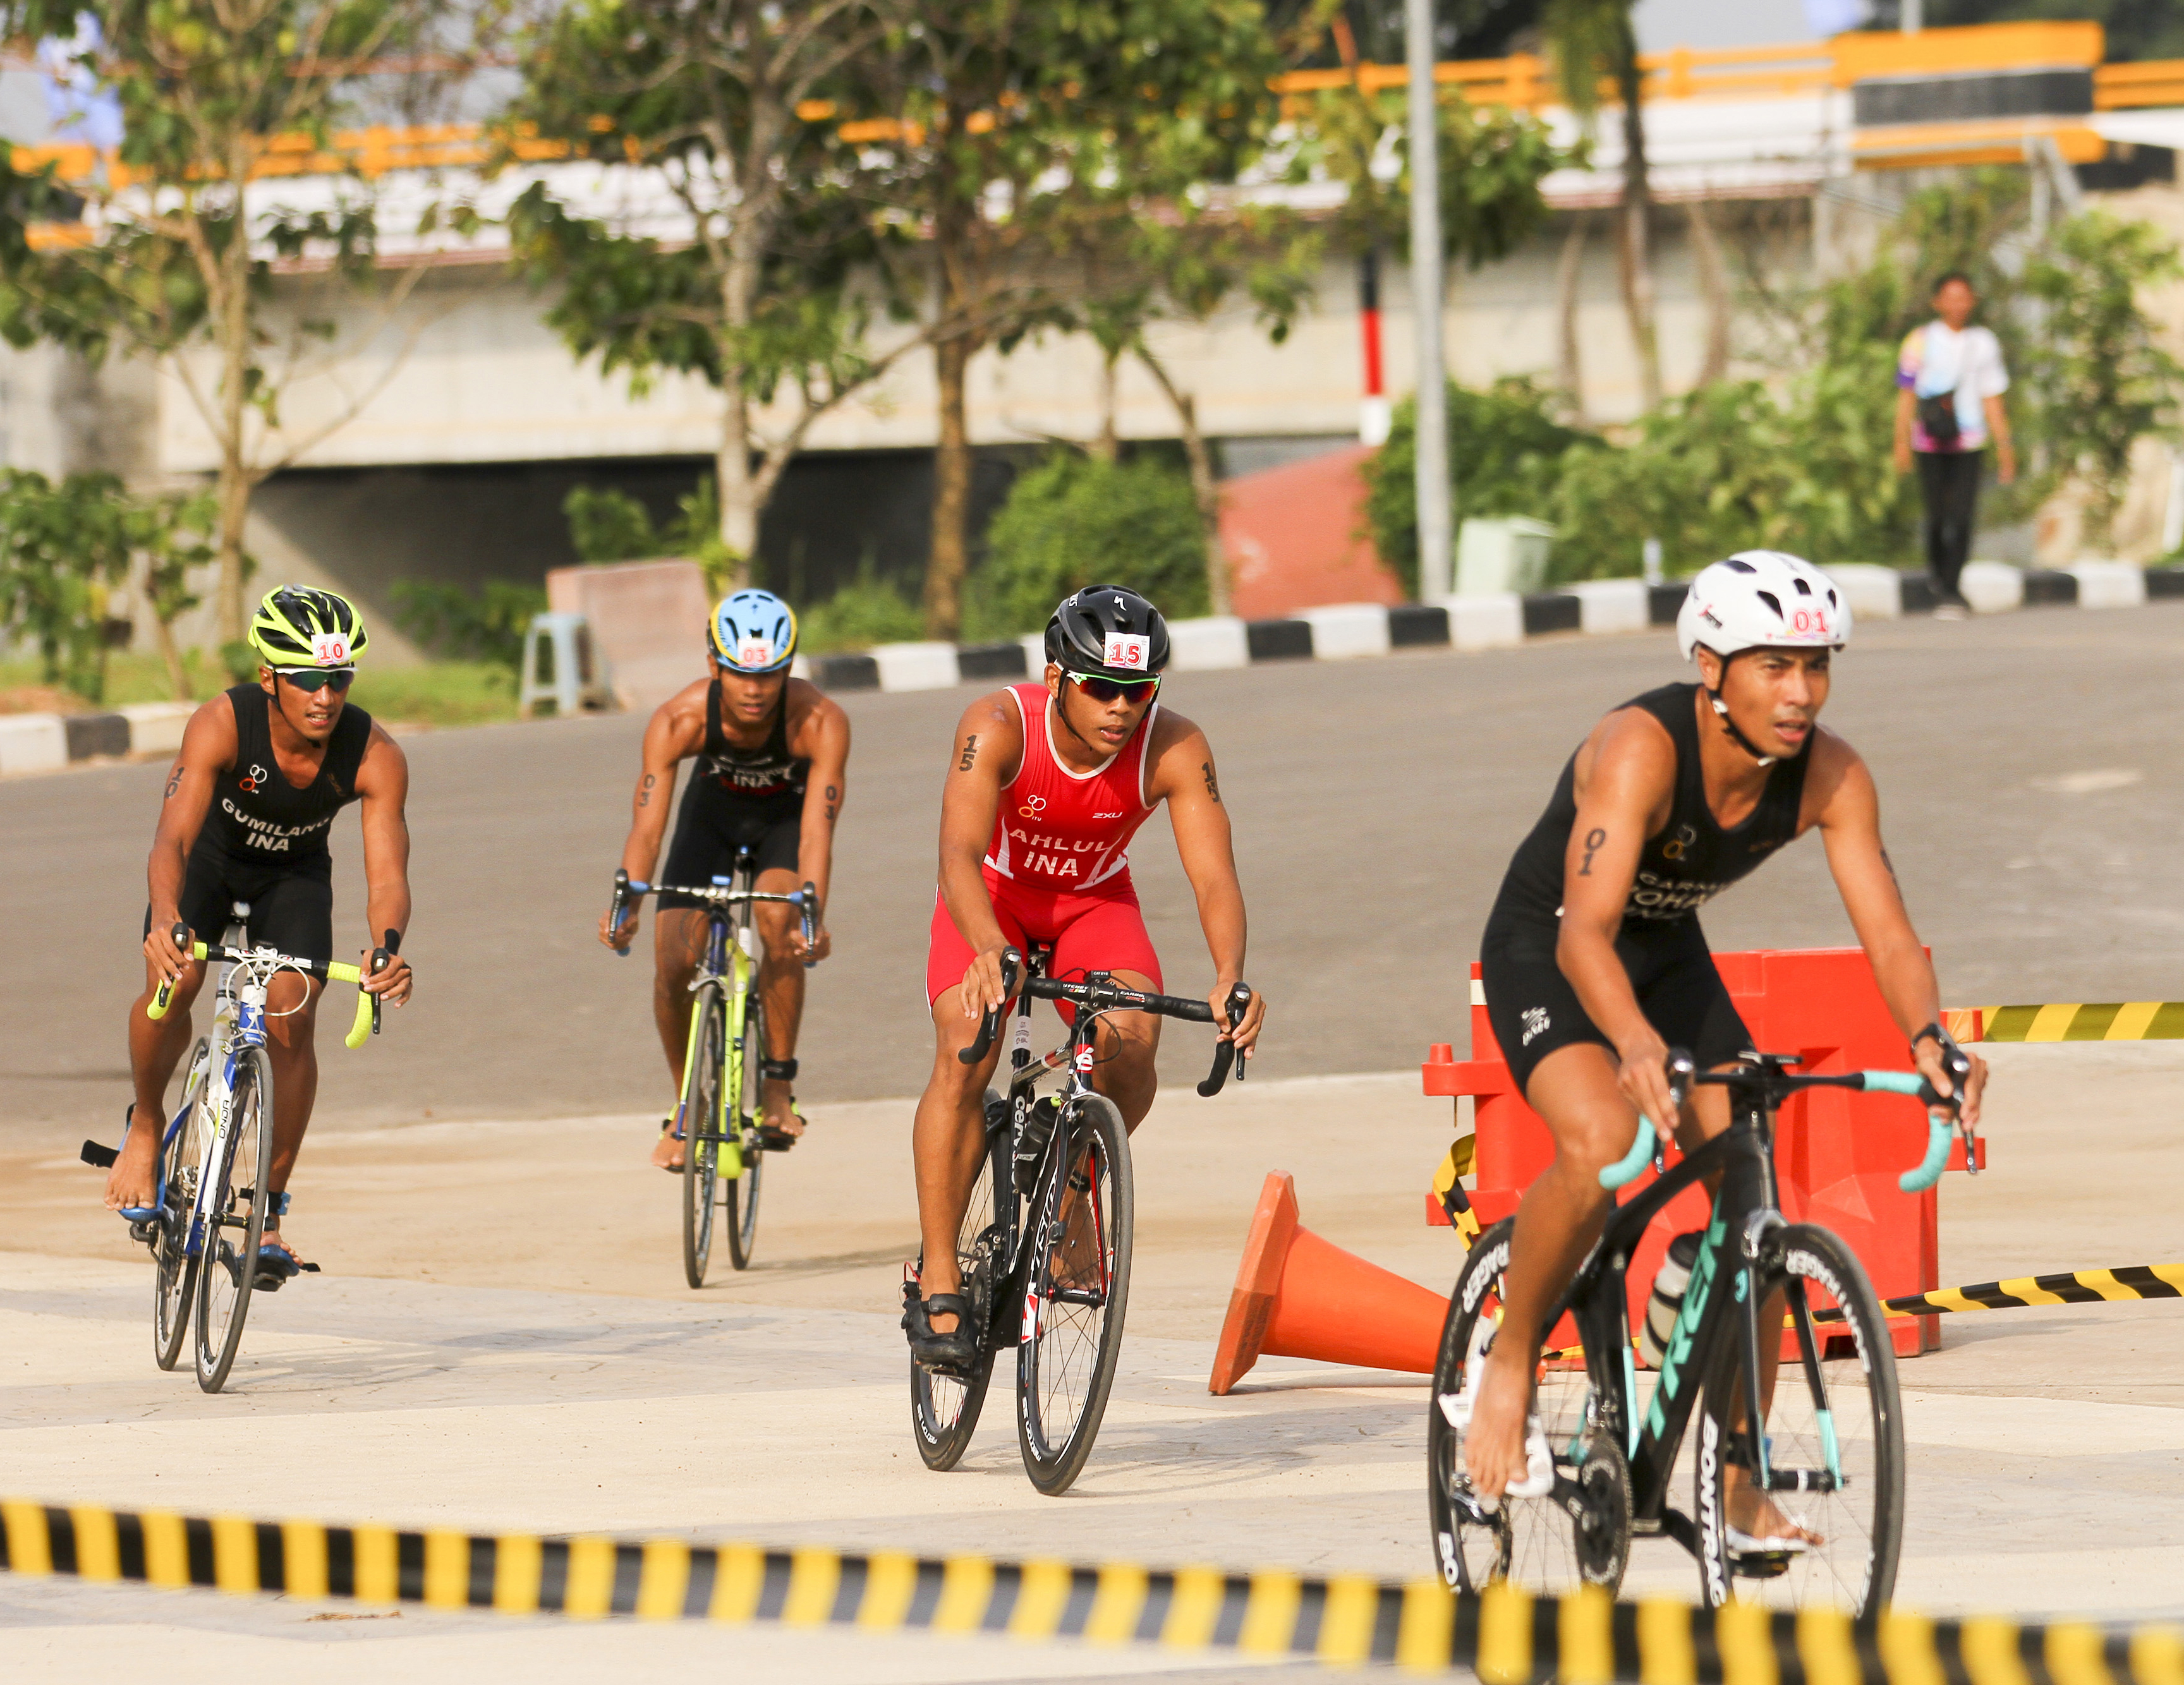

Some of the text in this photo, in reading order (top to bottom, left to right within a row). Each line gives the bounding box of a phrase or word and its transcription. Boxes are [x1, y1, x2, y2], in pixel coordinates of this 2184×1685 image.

[1793, 610, 1828, 635] 01
[317, 642, 344, 661] 10
[744, 648, 767, 663] 03
[1110, 642, 1141, 665] 15
[959, 734, 978, 771] 15
[164, 766, 185, 799] 10
[639, 775, 655, 807] 03
[733, 775, 774, 788] INA
[1201, 761, 1220, 802] 15
[825, 785, 837, 820] 03
[246, 832, 289, 851] INA
[1009, 828, 1111, 853] AHLUL
[1577, 828, 1606, 876] 01
[1024, 851, 1079, 876] INA
[219, 1099, 230, 1139] ONDA
[1462, 1240, 1510, 1314] RAGER
[1644, 1192, 1728, 1441] TREK
[1700, 1413, 1727, 1608] BONTRAG
